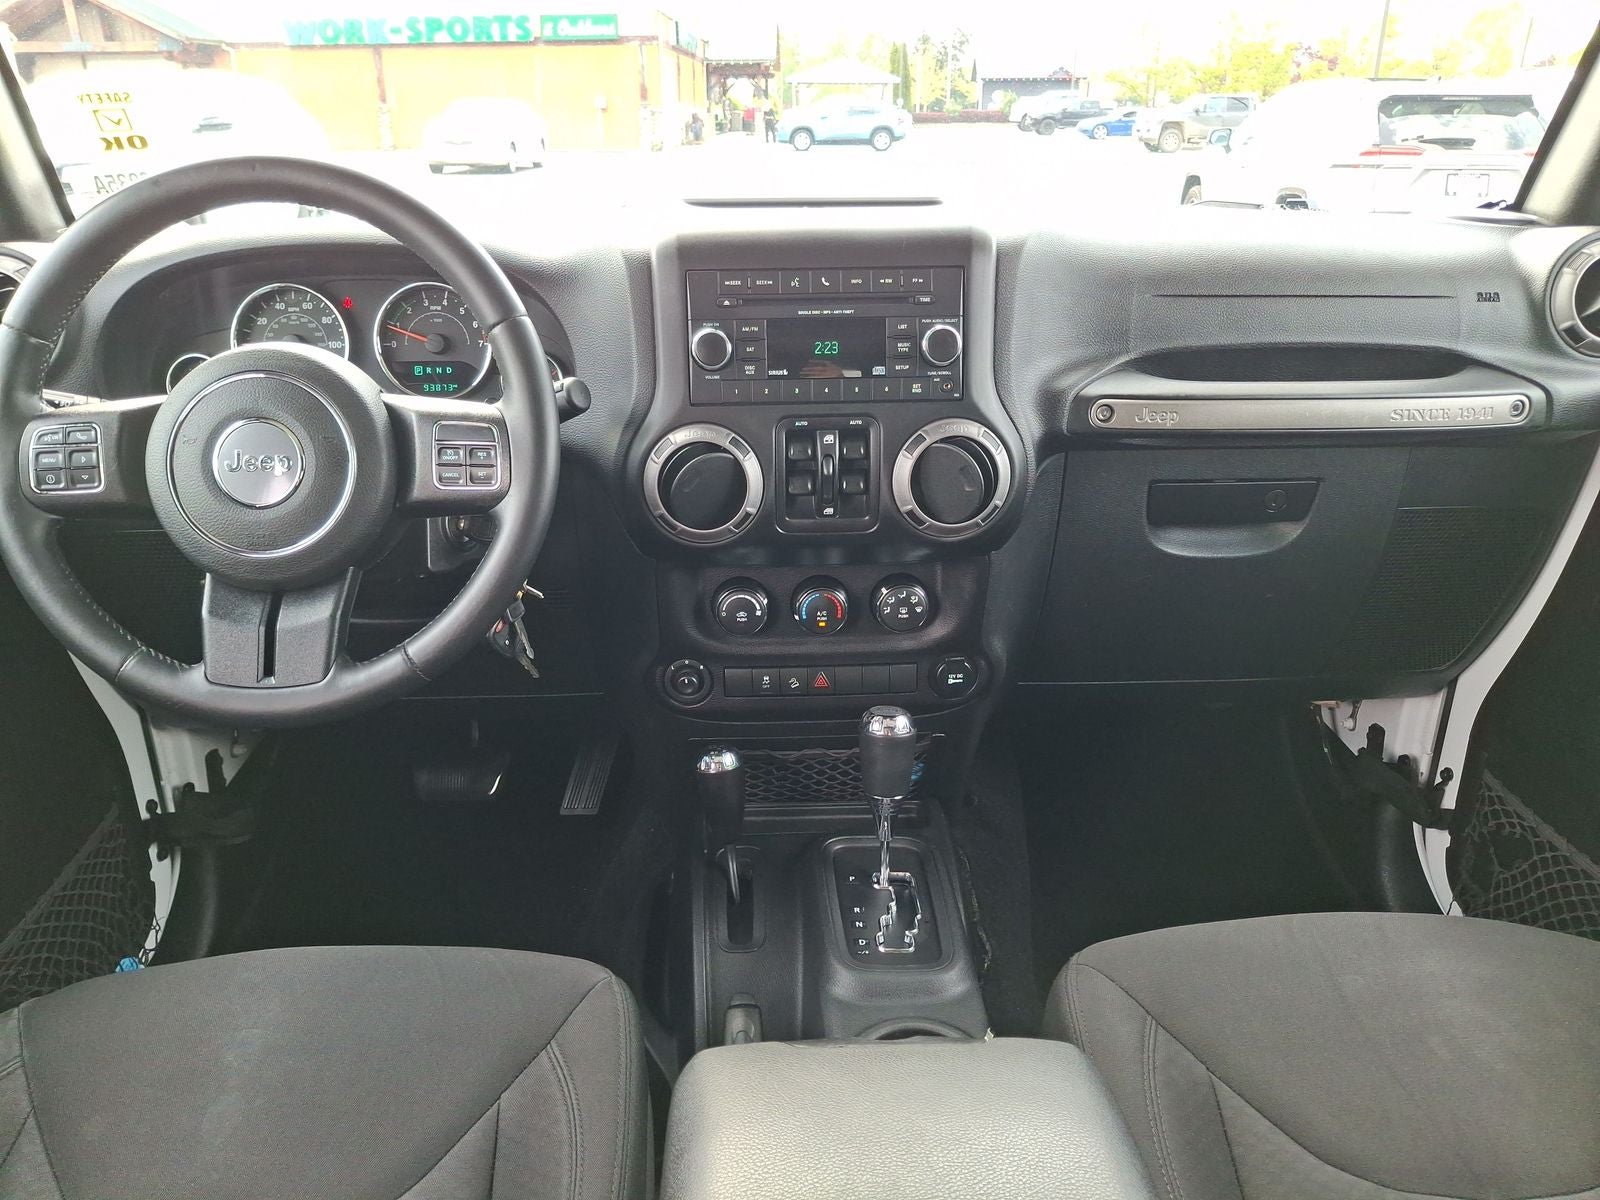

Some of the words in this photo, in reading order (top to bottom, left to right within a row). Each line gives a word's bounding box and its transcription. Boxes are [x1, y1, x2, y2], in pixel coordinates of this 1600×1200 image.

[284, 15, 533, 44] WORK-SPORTS
[274, 302, 285, 310] 40
[302, 302, 313, 310] 60
[423, 299, 429, 307] 3
[442, 299, 448, 307] 4
[460, 307, 465, 315] 5
[321, 316, 332, 324] 80
[472, 321, 478, 329] 6
[328, 341, 342, 349] 100
[478, 340, 484, 348] 7
[815, 341, 839, 354] 2:23
[1135, 406, 1179, 427] Jeep
[1390, 408, 1450, 422] SINCE
[1456, 406, 1494, 421] 1941
[224, 449, 293, 476] Jeep
